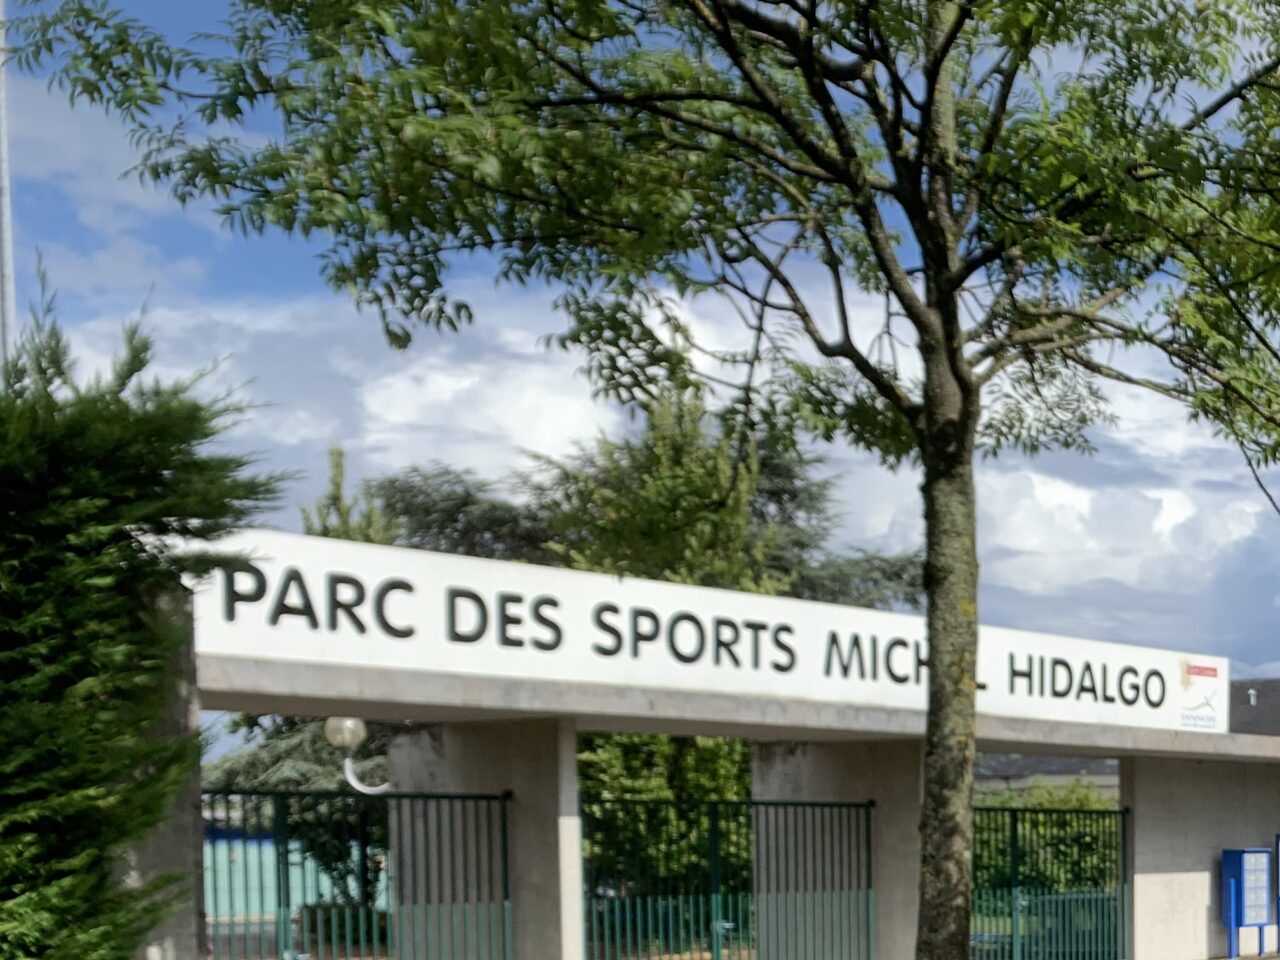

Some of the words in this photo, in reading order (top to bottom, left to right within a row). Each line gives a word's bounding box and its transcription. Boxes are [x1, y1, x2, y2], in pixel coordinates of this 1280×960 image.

[221, 562, 415, 640] PARC
[445, 586, 564, 653] DES
[591, 602, 797, 673] SPORTS
[824, 630, 988, 690] MICH
[1008, 651, 1167, 709] HIDALGO
